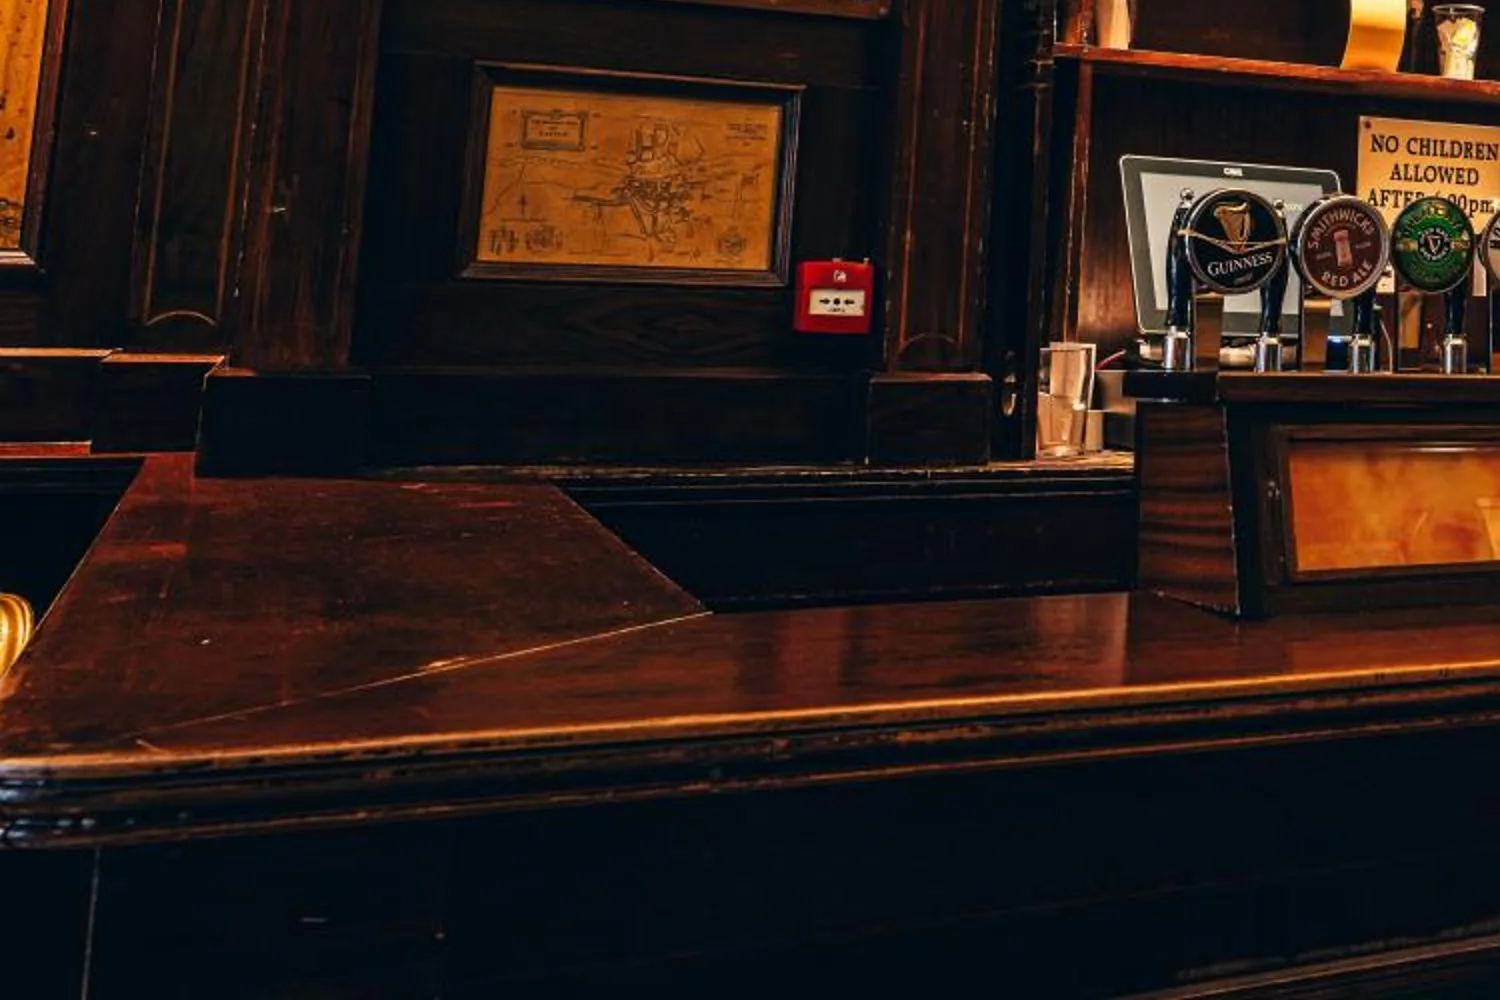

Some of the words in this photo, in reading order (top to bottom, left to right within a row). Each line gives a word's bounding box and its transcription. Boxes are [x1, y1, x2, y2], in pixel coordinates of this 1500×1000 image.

[1370, 133, 1400, 153] NO
[1406, 136, 1499, 161] CHILDREN
[1390, 161, 1479, 186] ALLOWED
[1207, 251, 1274, 277] GUINNESS
[1321, 271, 1350, 288] RED
[1353, 258, 1374, 284] ALE
